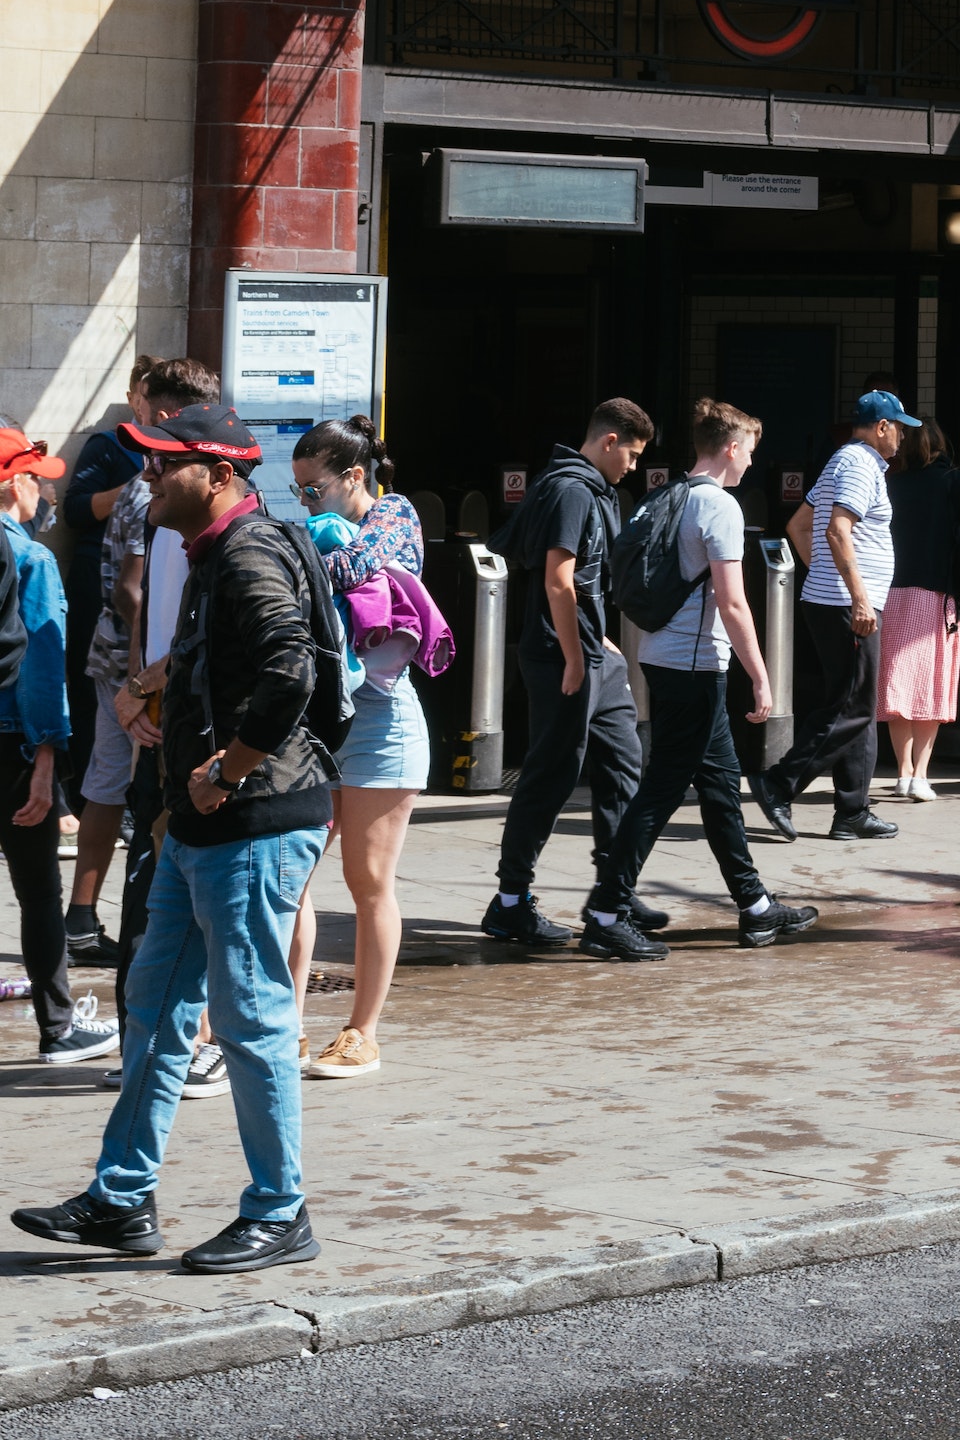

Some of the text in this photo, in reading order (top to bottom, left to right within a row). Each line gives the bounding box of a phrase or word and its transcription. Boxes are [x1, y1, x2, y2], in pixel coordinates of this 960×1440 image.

[722, 174, 743, 182] Please
[759, 176, 770, 184] the
[772, 177, 801, 185] entrance
[766, 185, 778, 193] the
[780, 186, 801, 194] corner
[242, 291, 280, 299] Northern line
